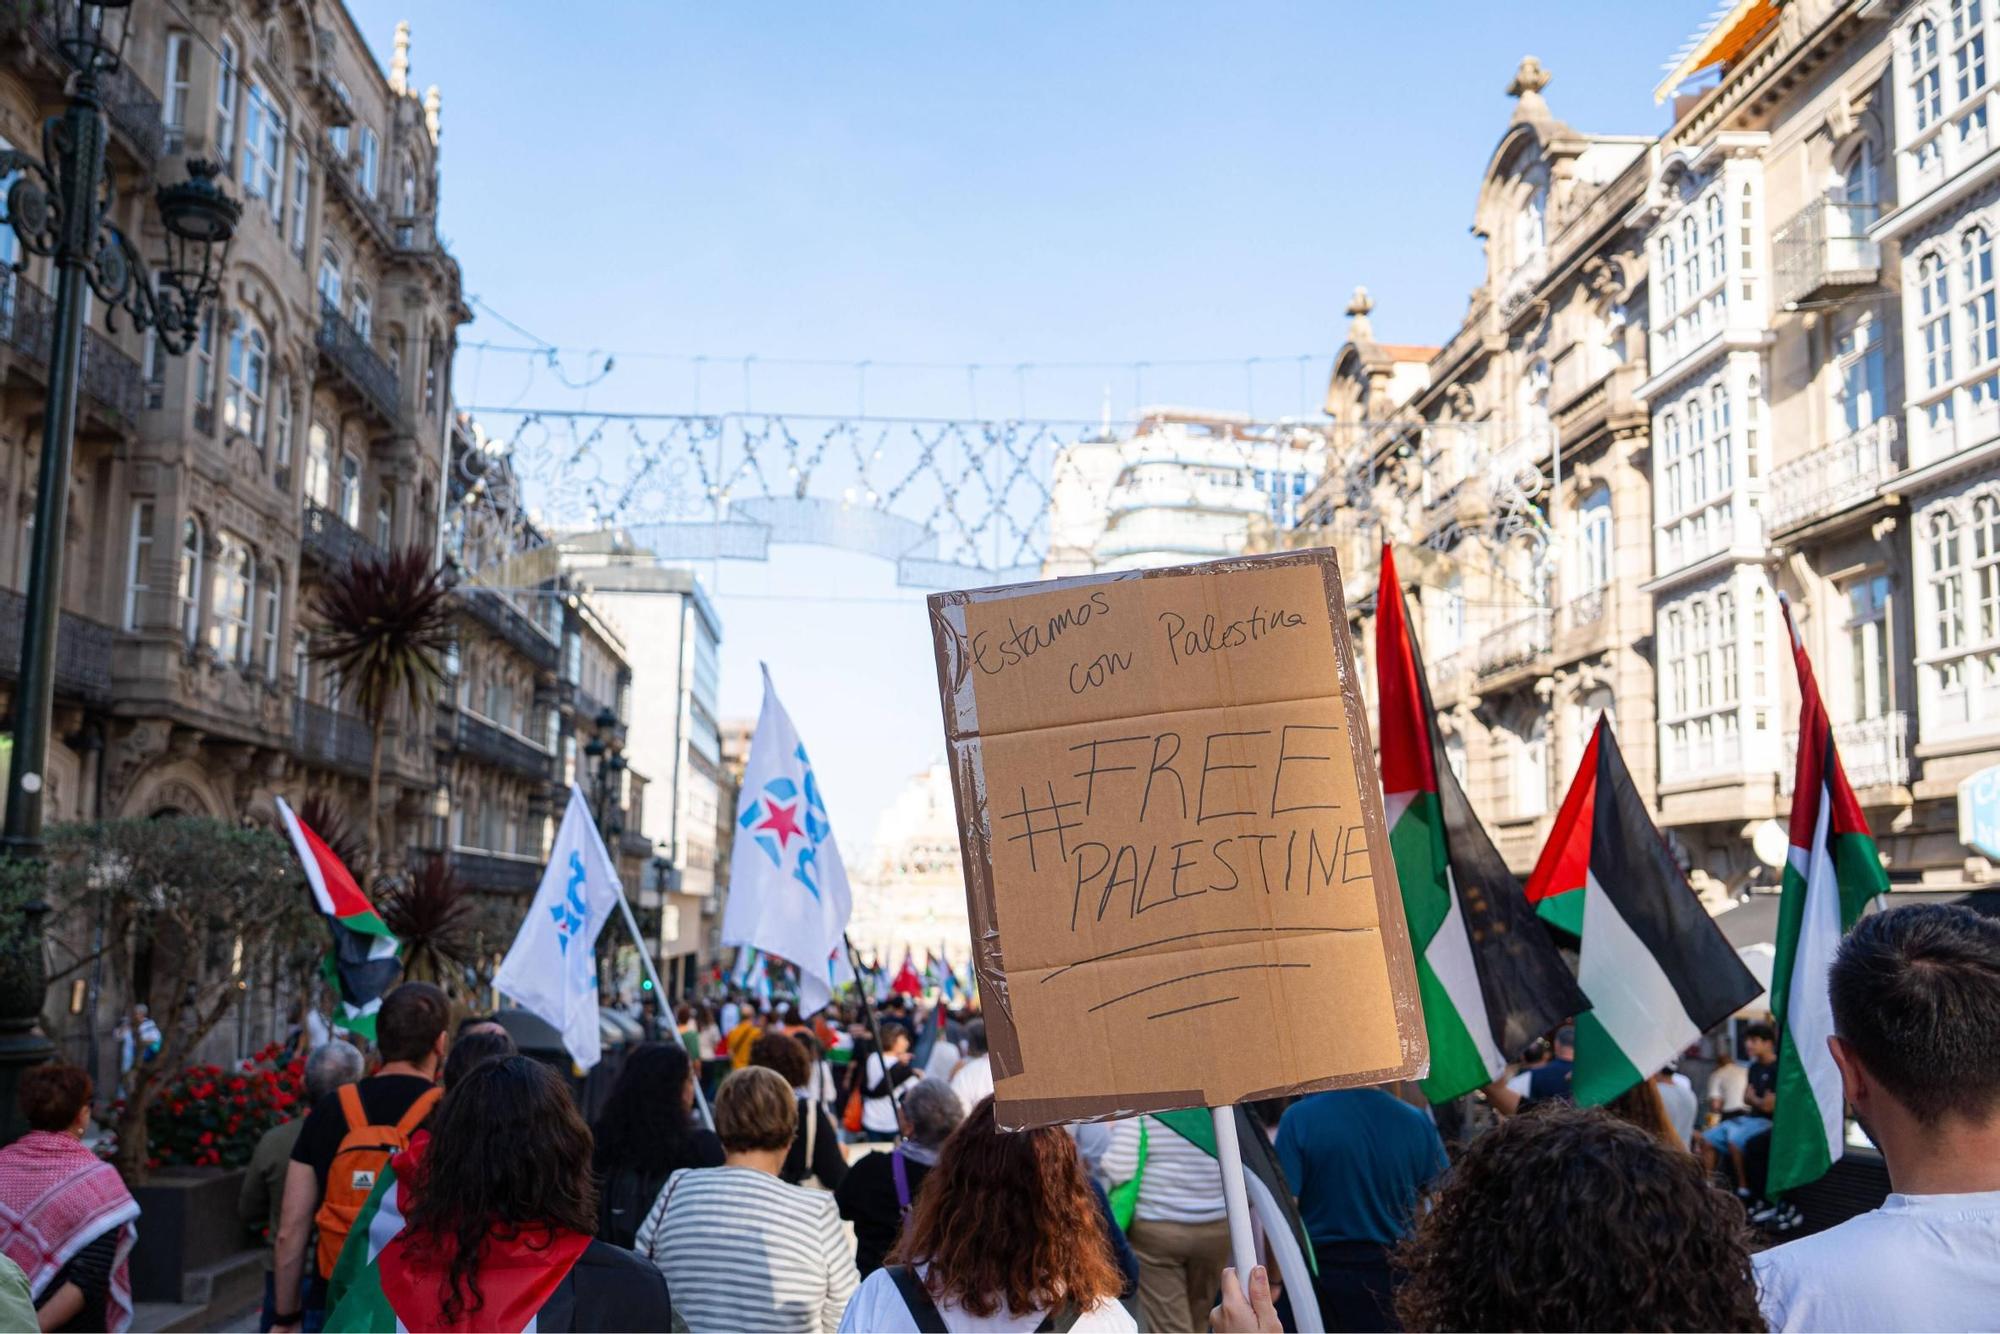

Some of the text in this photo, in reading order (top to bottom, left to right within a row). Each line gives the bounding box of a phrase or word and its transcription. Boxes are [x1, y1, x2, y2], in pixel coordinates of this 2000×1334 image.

[972, 591, 1110, 675] Estamos
[1069, 605, 1306, 694] con Palestina
[1071, 825, 1373, 931] PALESTINE
